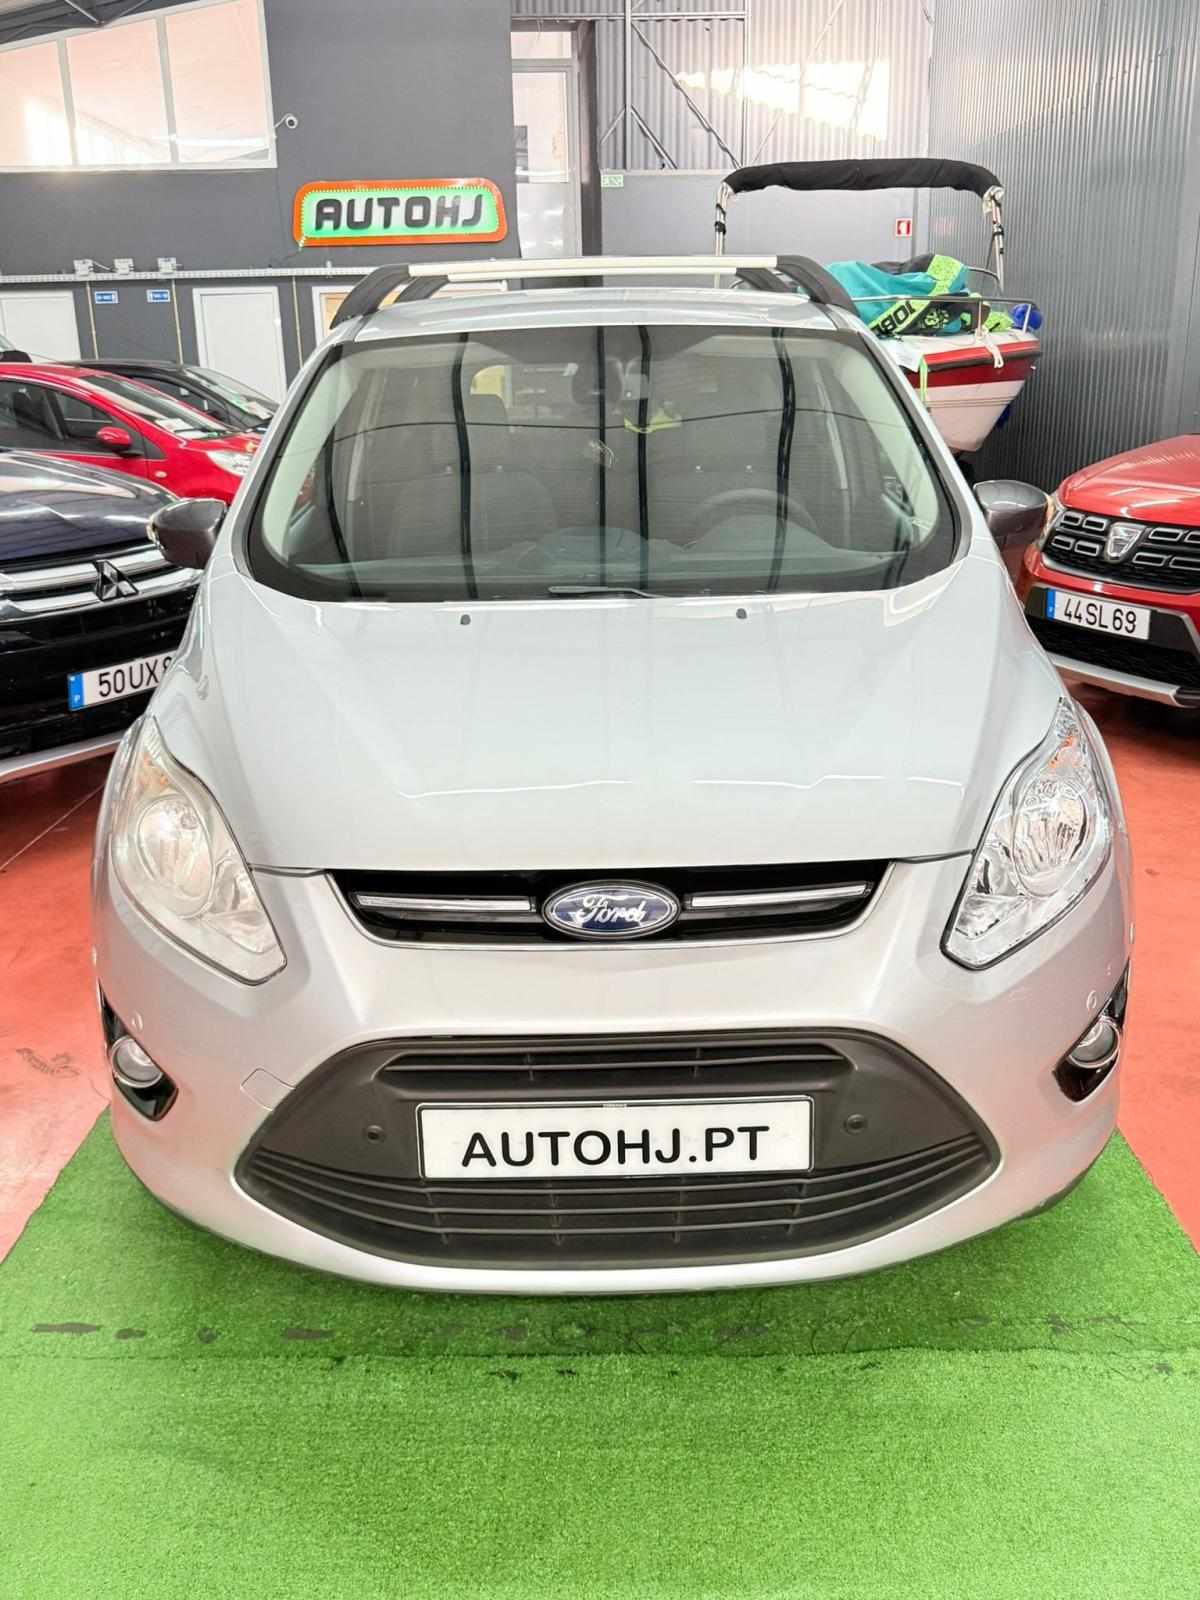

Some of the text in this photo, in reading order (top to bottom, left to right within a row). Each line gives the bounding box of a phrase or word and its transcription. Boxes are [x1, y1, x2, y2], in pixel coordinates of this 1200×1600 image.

[315, 194, 483, 230] AUTOHJ
[1064, 598, 1137, 633] 44SL69
[567, 893, 648, 922] Ford
[462, 1125, 770, 1167] AUTOHJ.PT
